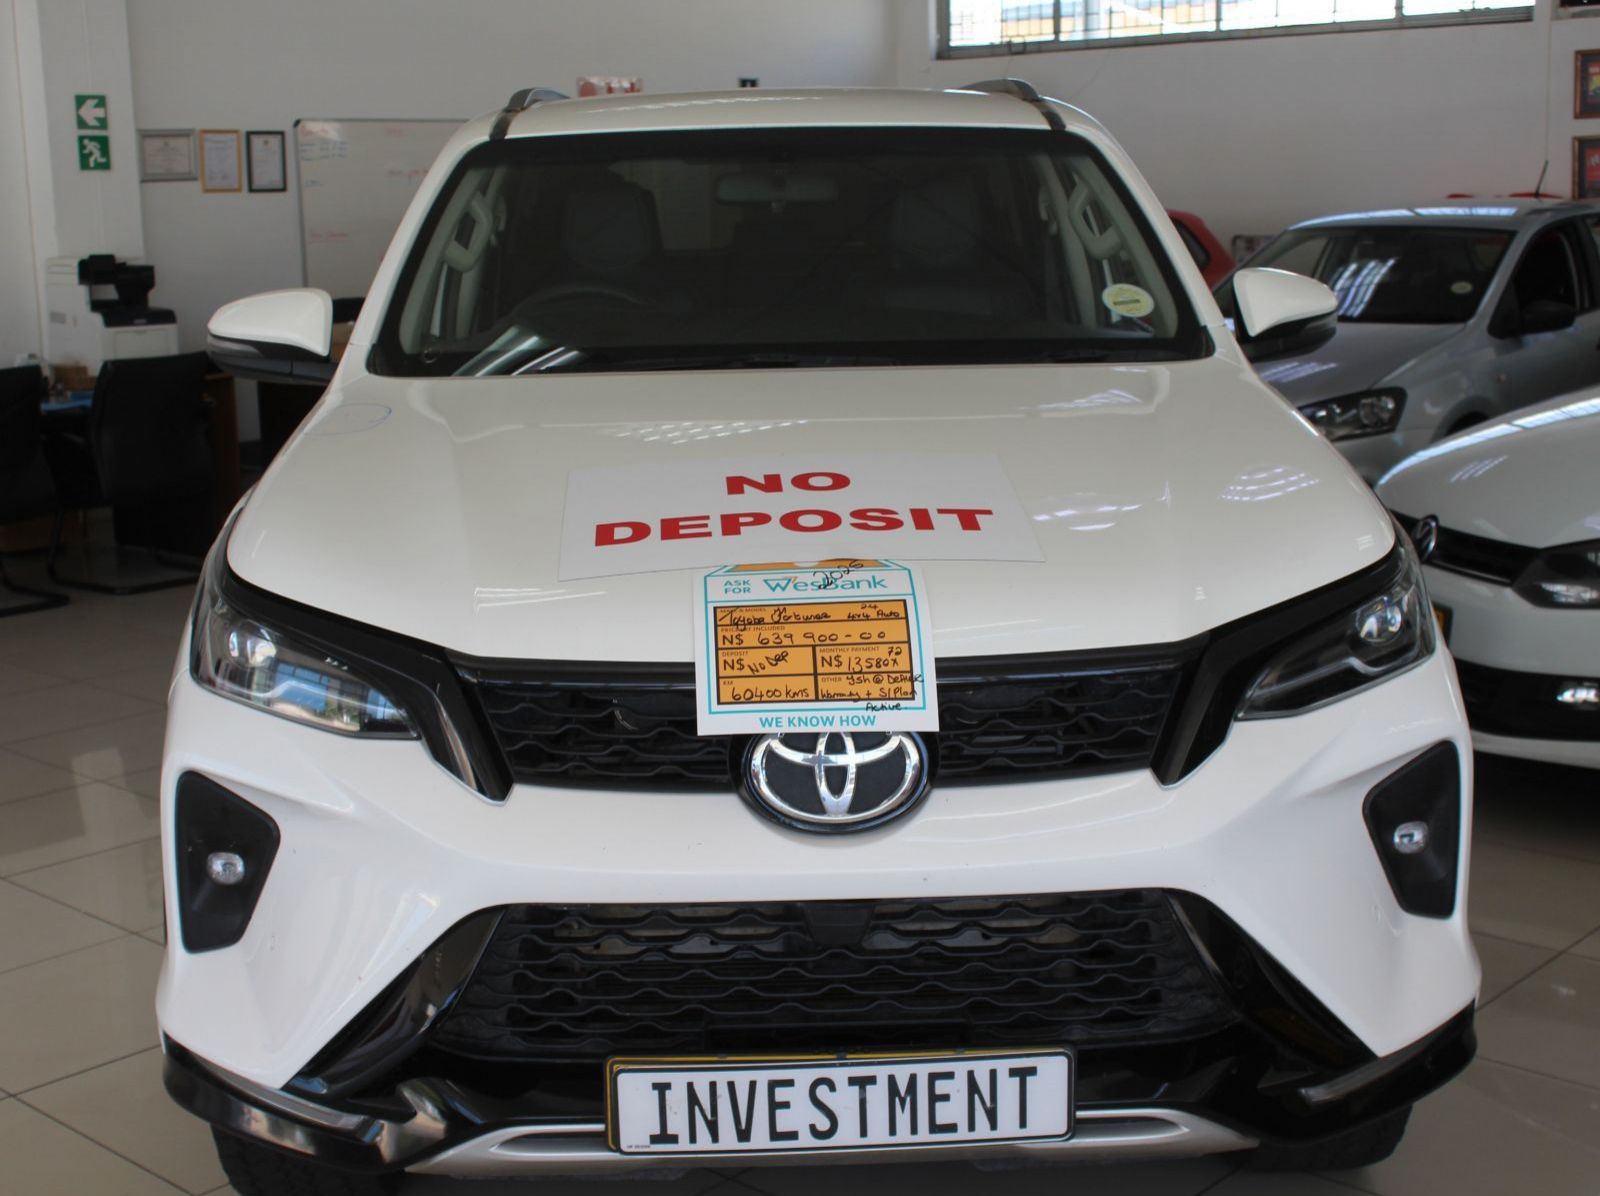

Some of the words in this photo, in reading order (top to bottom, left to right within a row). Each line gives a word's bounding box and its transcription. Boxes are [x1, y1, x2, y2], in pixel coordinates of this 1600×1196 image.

[726, 472, 850, 495] NO
[595, 508, 993, 547] DEPOSIT
[763, 575, 888, 593] WesBank
[722, 633, 744, 646] N$
[758, 631, 794, 645] 639
[723, 658, 745, 671] N$
[821, 654, 843, 668] N$
[731, 686, 782, 702] 60400
[865, 702, 902, 712] Active
[760, 716, 783, 728] WE
[787, 715, 835, 728] KNOW
[840, 714, 876, 727] HOW
[649, 1066, 1038, 1145] INVESTMENT
